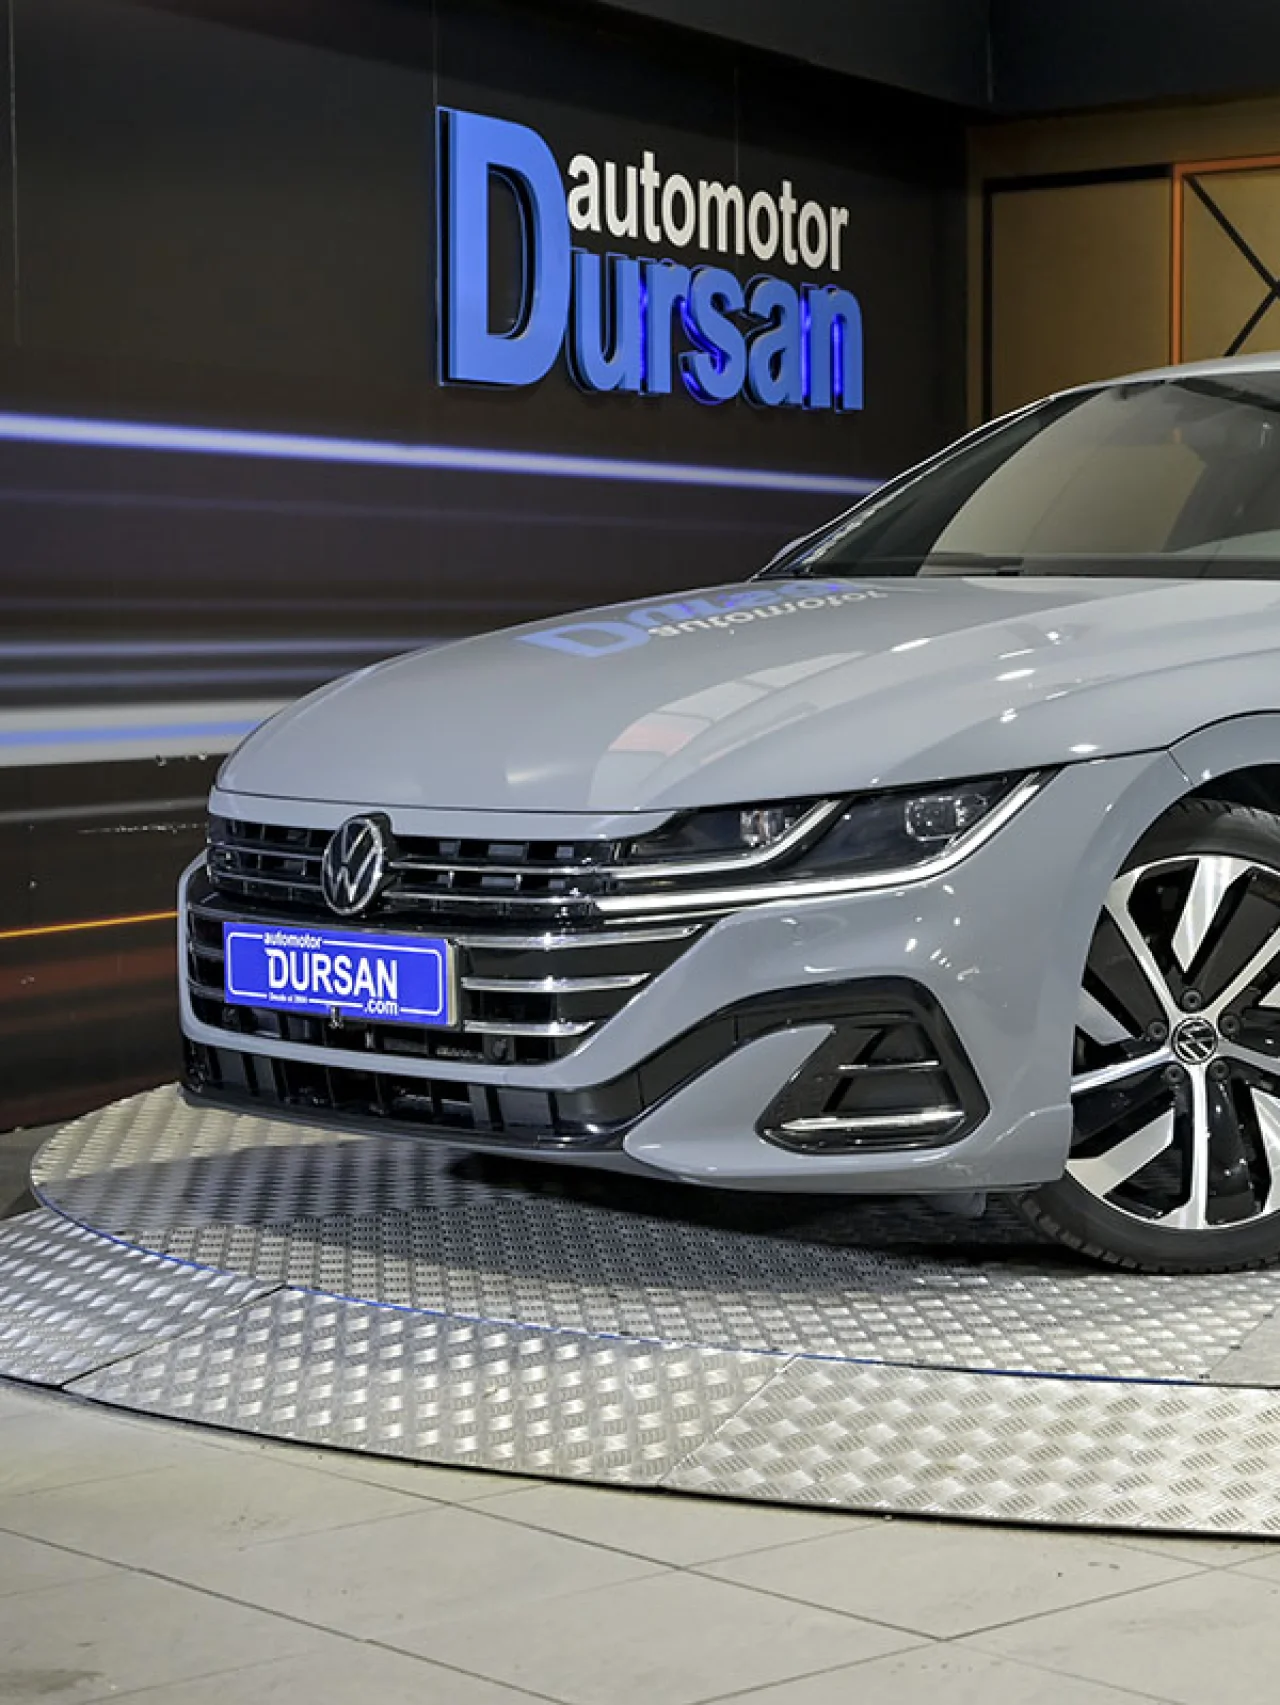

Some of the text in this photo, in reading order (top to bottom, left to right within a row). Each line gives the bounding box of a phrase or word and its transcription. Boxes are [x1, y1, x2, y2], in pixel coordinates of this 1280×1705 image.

[567, 151, 849, 271] automotor
[436, 105, 864, 412] Dursan
[264, 948, 398, 999] DURSAN
[364, 999, 399, 1016] .com
